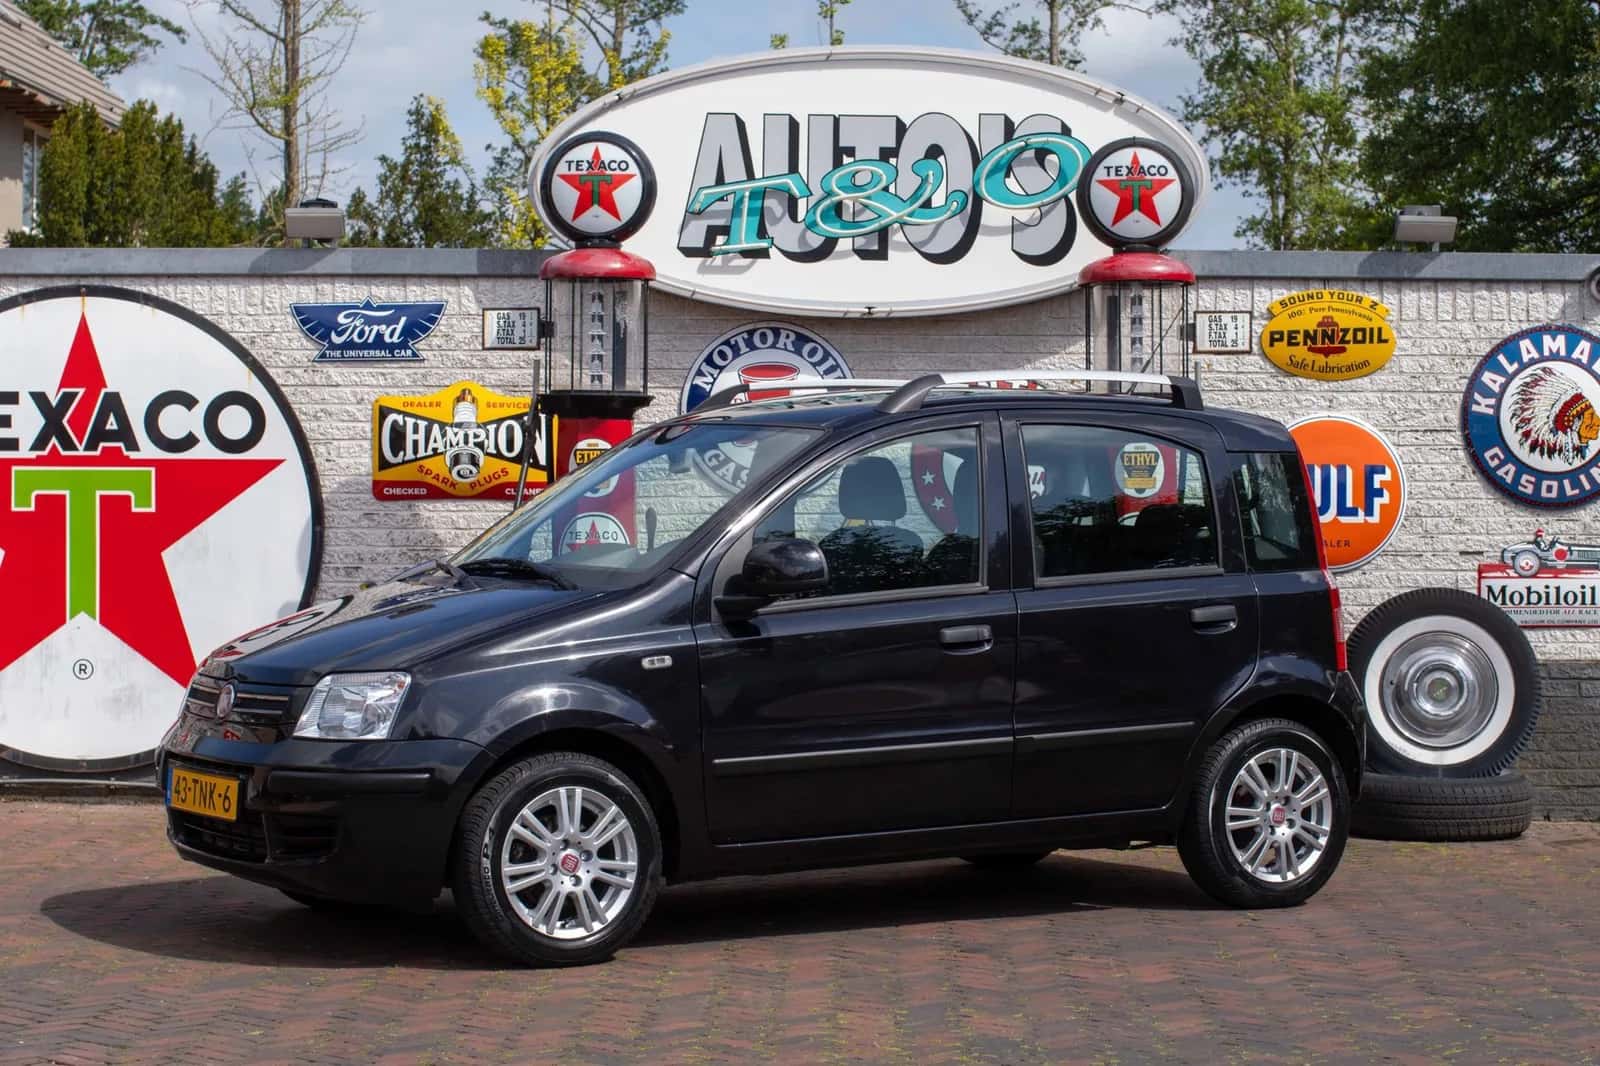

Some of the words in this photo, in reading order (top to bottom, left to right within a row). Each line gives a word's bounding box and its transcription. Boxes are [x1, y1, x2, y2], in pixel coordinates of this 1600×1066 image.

[565, 159, 629, 171] TEXACO
[1104, 165, 1168, 176] TEXACO
[677, 112, 1076, 266] AUTO'S
[1279, 291, 1324, 309] SOUND
[1327, 291, 1363, 304] YOUR
[1369, 300, 1379, 310] Z
[496, 312, 511, 320] GAS
[1208, 315, 1223, 323] GAS
[331, 309, 408, 344] Ford
[1269, 327, 1389, 347] PENNZOIL
[325, 350, 342, 358] THE
[692, 328, 796, 391] MOTOR
[1287, 354, 1310, 370] Safe
[1311, 359, 1370, 374] Lubrication
[402, 400, 441, 408] DEALER
[381, 412, 547, 466] CHAMPION
[1123, 453, 1158, 466] ETHYL
[417, 464, 458, 490] SPARK
[470, 467, 510, 490] PLUGS
[383, 487, 427, 495] CHECKED
[504, 487, 544, 496] CLANE
[569, 530, 619, 541] TEXACO
[1486, 584, 1597, 606] Mobiloil
[174, 775, 232, 813] 43-TNK-6
